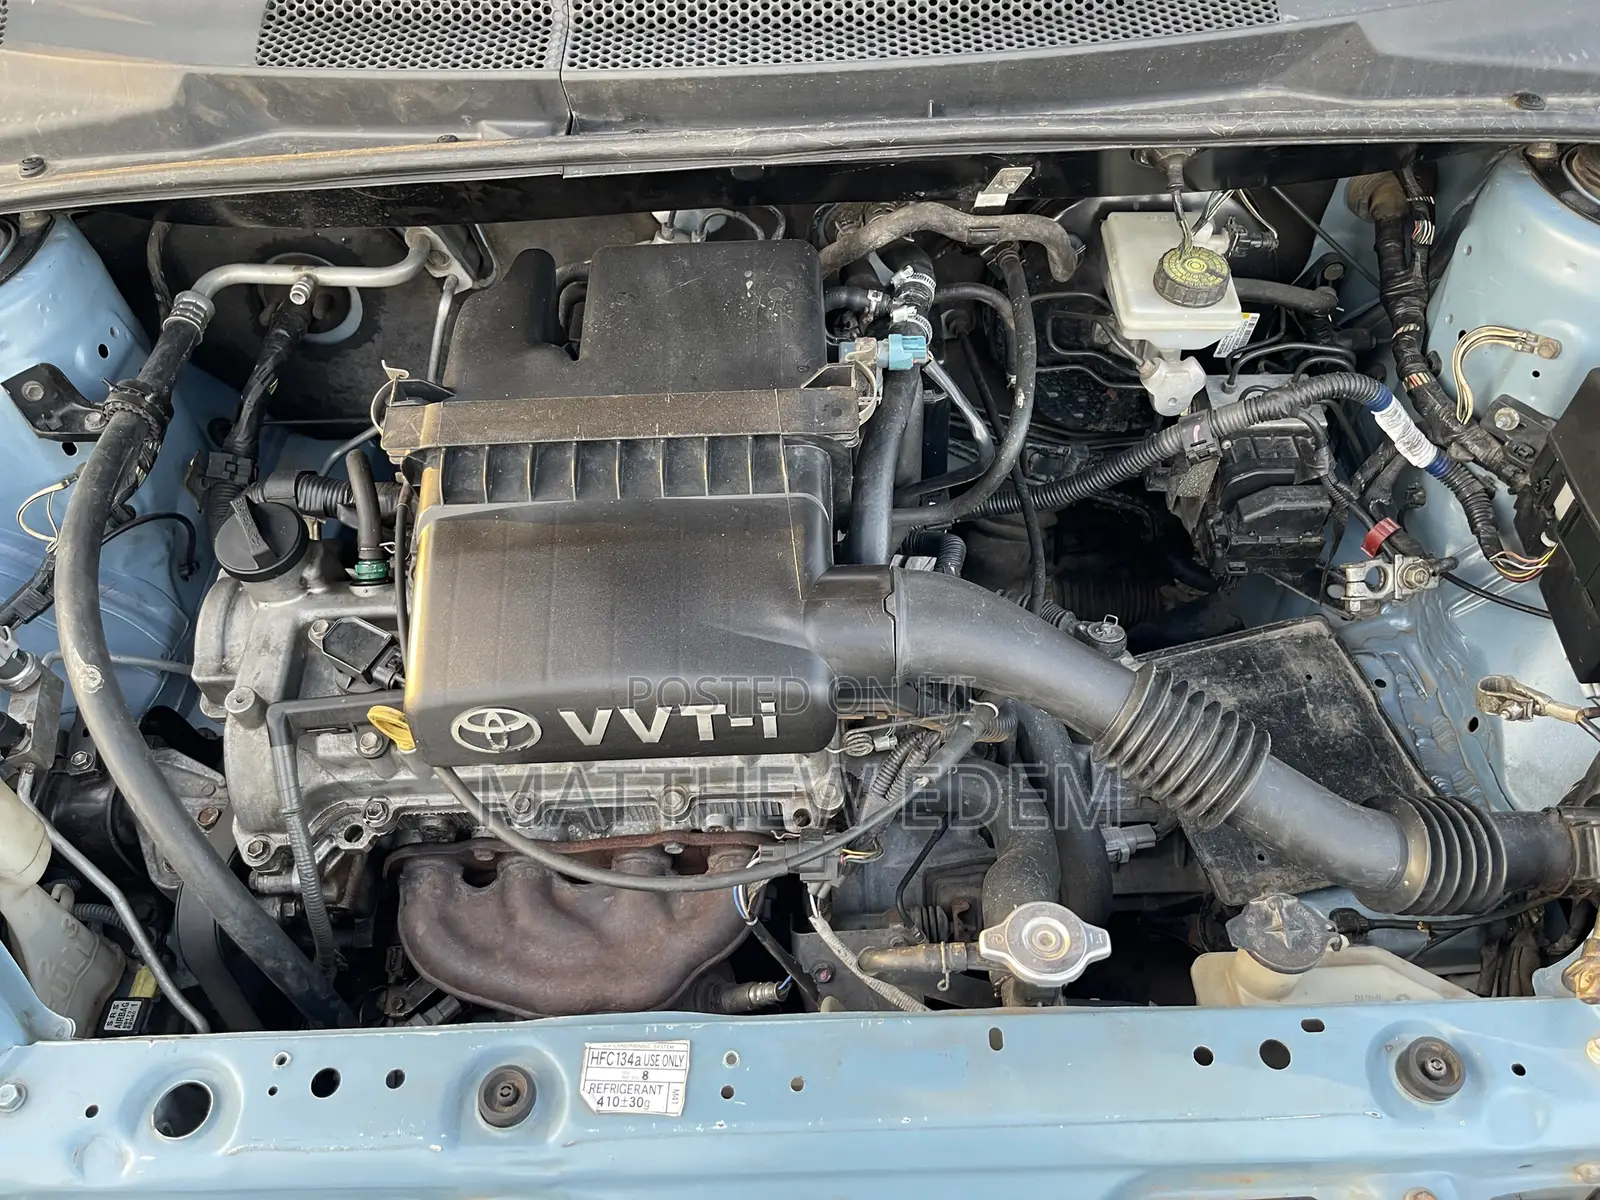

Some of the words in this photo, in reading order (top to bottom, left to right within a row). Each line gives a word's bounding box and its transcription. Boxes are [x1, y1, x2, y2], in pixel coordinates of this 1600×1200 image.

[557, 700, 778, 747] VVT-i
[114, 1002, 130, 1029] AIRBAG
[590, 1051, 641, 1067] HFC134a
[643, 1053, 661, 1067] USE
[662, 1053, 685, 1068] ONLY
[641, 1070, 649, 1081] 8
[588, 1082, 665, 1095] REFRIGERANT
[596, 1095, 651, 1111] 410±30g
